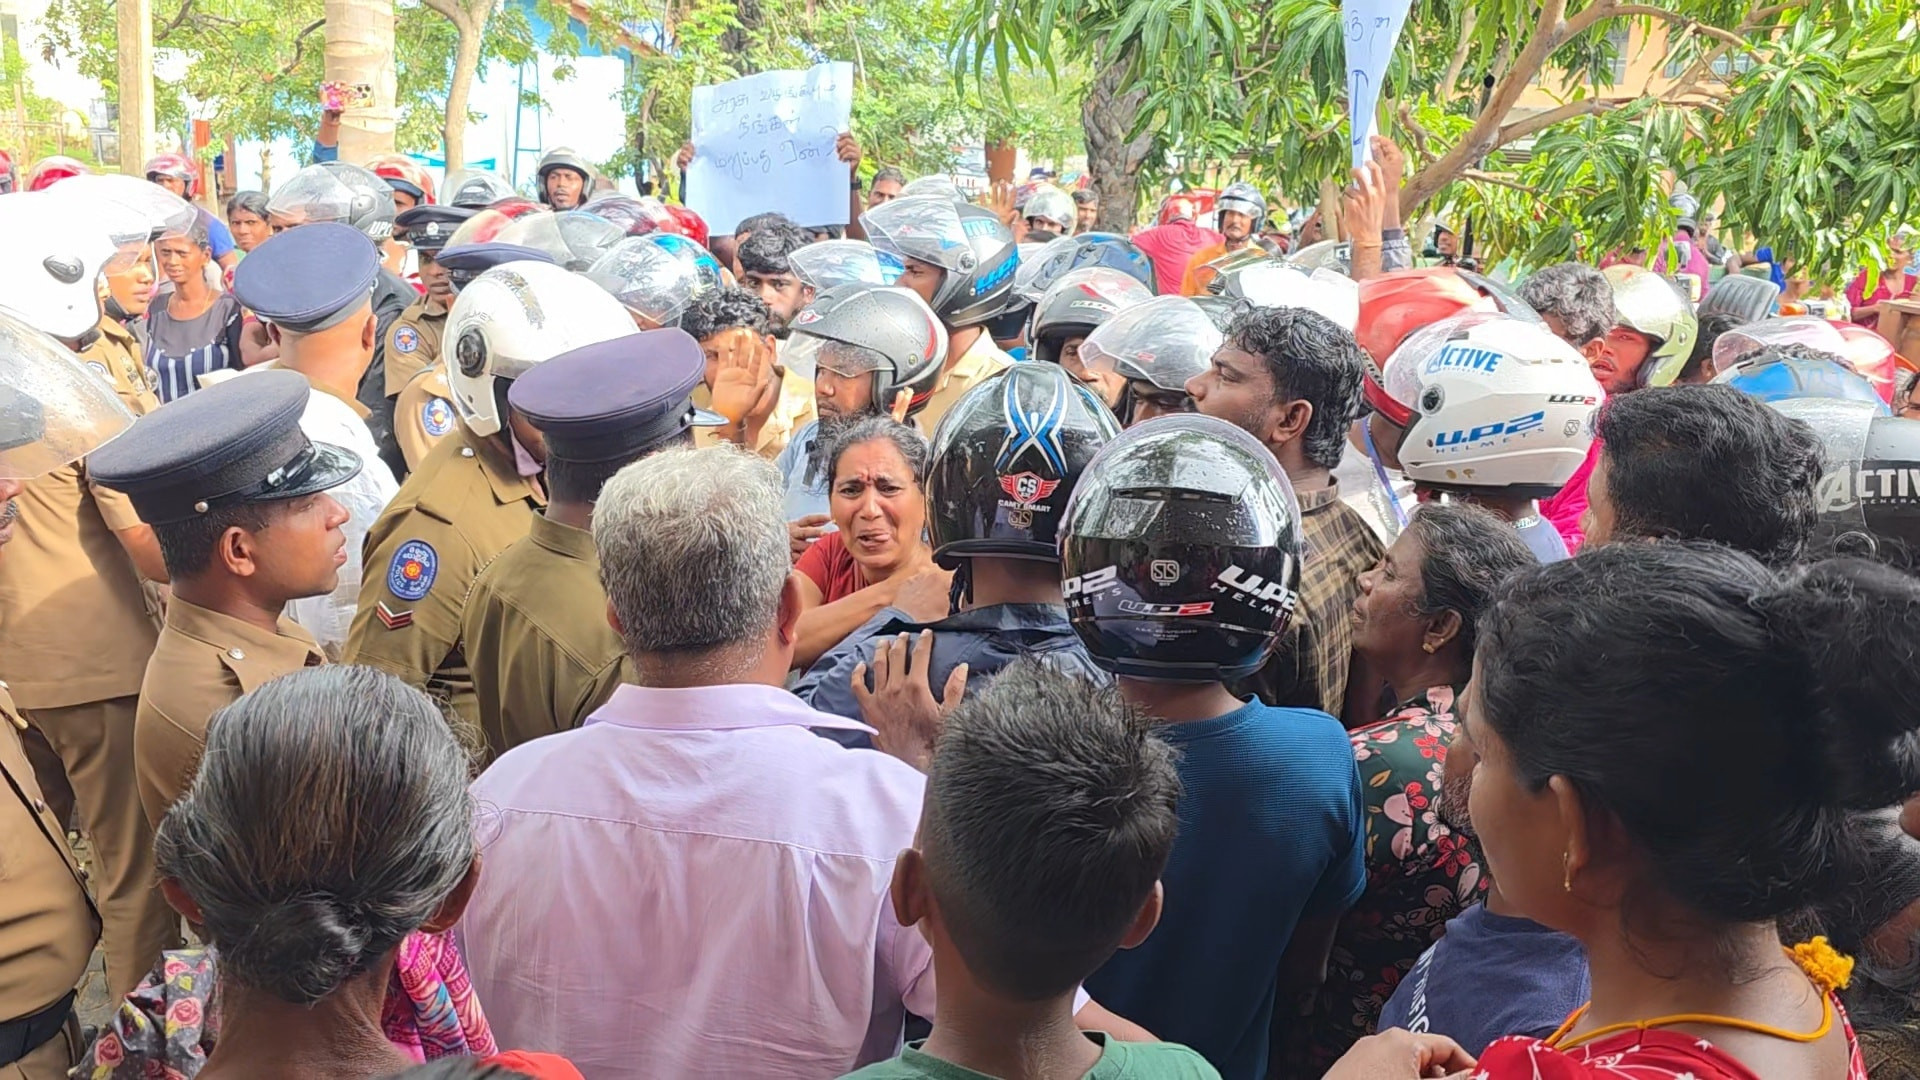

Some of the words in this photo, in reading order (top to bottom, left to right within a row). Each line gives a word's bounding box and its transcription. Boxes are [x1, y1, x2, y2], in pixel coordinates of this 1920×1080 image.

[1424, 344, 1504, 375] ACTIVE
[1017, 477, 1037, 494] CS
[1061, 564, 1117, 599] P2
